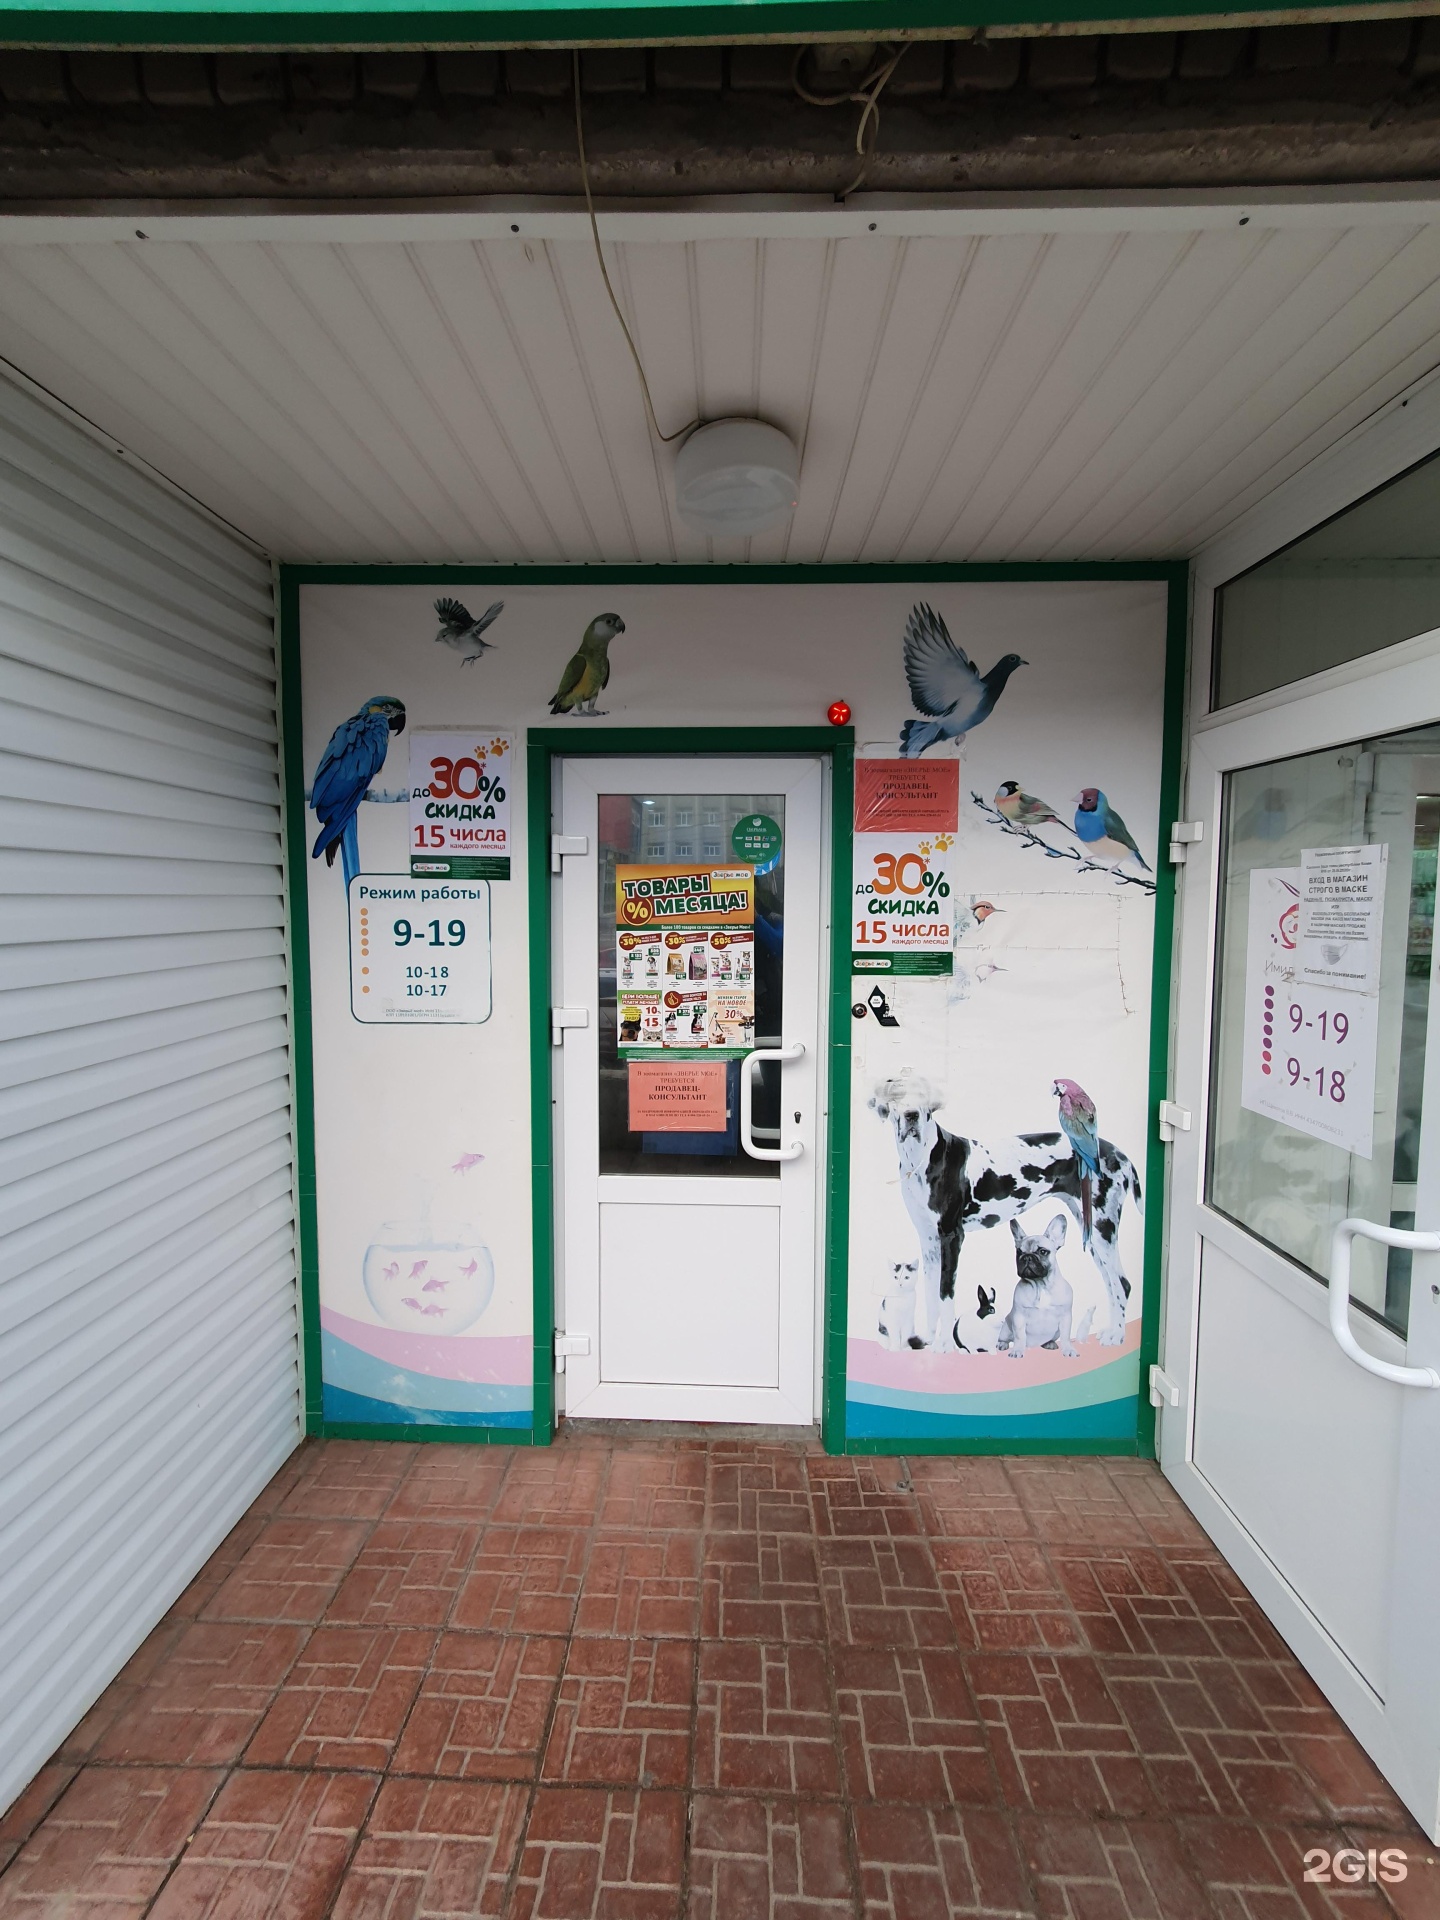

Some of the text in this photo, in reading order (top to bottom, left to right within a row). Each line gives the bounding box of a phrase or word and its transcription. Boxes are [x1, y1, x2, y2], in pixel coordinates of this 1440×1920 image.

[413, 788, 430, 798] до
[425, 802, 496, 821] СКИДКА
[414, 825, 506, 848] 15 числа
[450, 843, 479, 851] каждого
[624, 876, 709, 897] ТОВАРЫ
[1308, 874, 1368, 884] ВХОД В МАГАЗИН
[359, 886, 481, 902] Режим работы
[855, 885, 874, 895] до
[1308, 886, 1334, 894] СТРОГО
[1341, 885, 1368, 893] МАСКЕ
[655, 892, 746, 915] МЕСЯЦА!
[867, 898, 939, 917] СКИДКА
[393, 919, 466, 947] 9-19
[856, 920, 949, 944] 15 числа
[406, 966, 449, 979] 10-18
[1303, 967, 1326, 975] Спасибо
[1332, 972, 1367, 980] понимание!
[406, 984, 447, 997] 10-17
[1289, 1003, 1349, 1045] 9-19
[1287, 1057, 1346, 1103] 9-18
[655, 1085, 700, 1093] ПРОДАВЕЦ-
